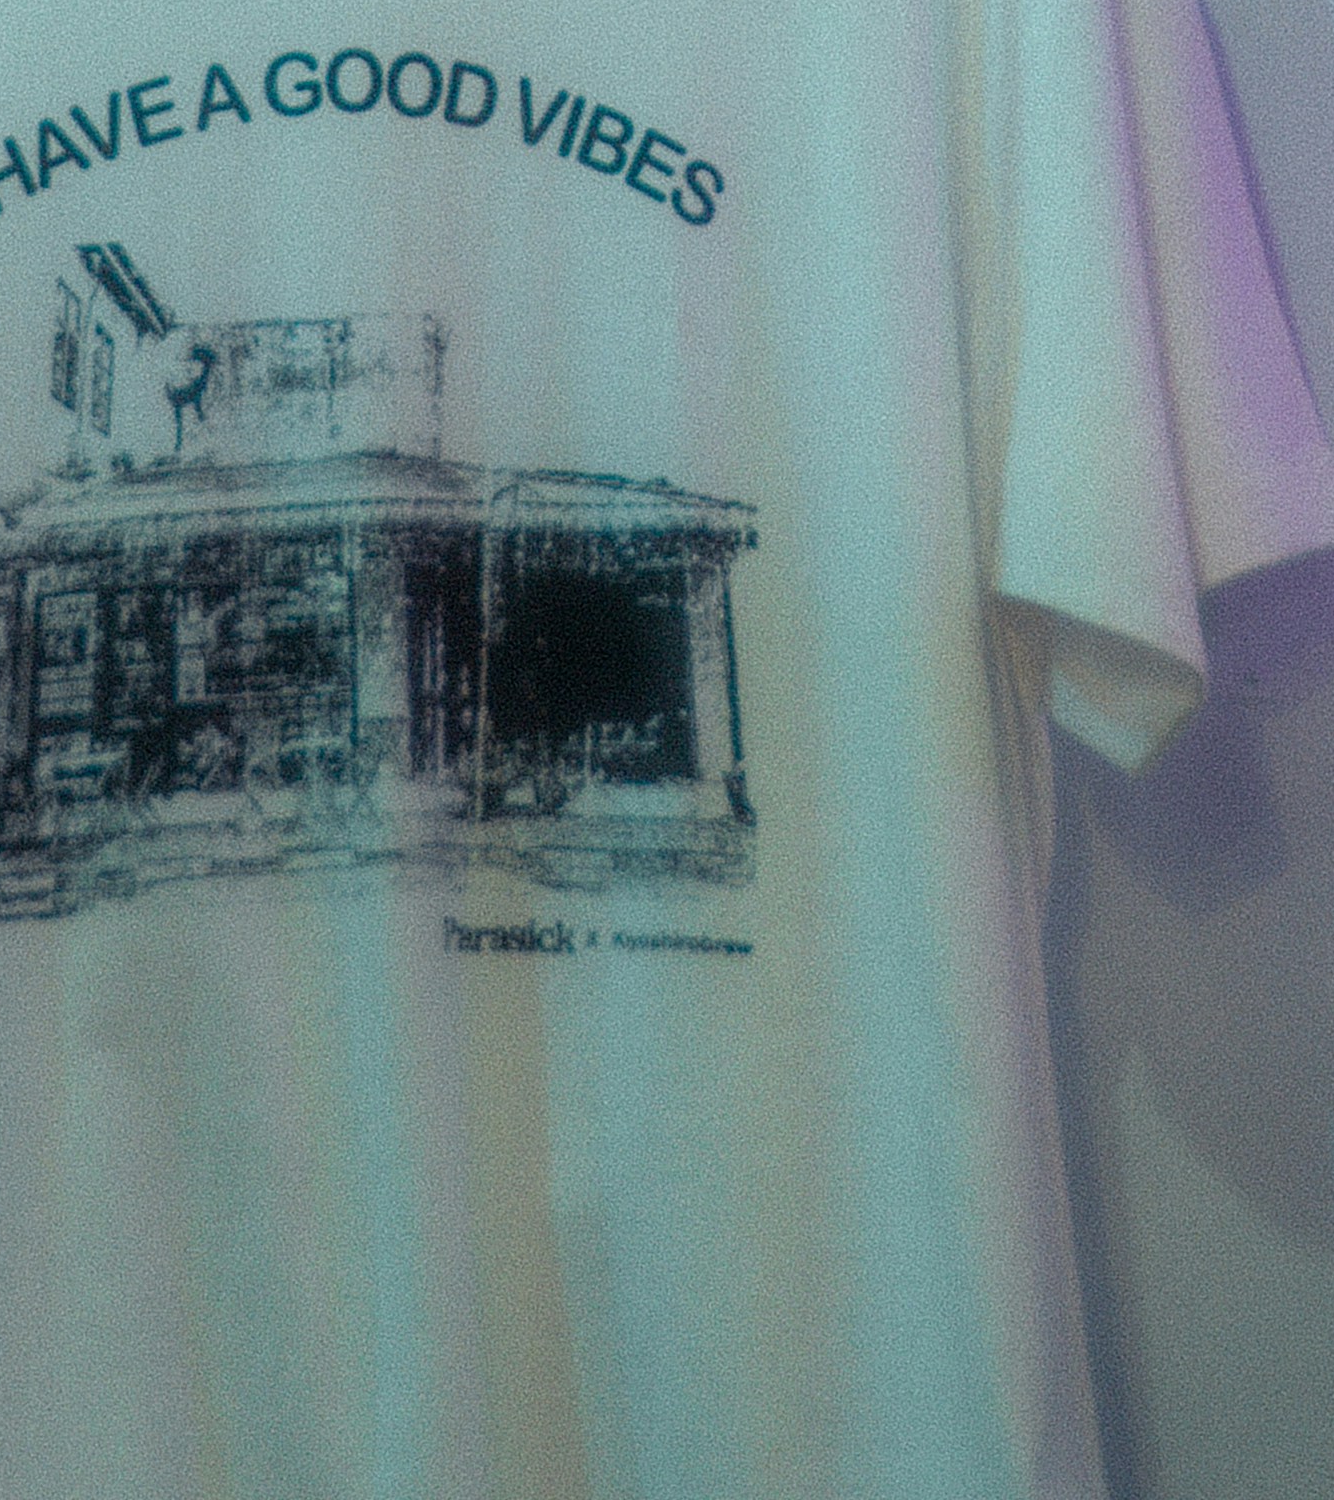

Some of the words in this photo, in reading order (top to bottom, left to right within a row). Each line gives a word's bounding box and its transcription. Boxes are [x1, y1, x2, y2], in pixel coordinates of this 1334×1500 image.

[196, 62, 252, 132] A
[265, 47, 500, 128] GOOD
[517, 76, 725, 227] VIBES
